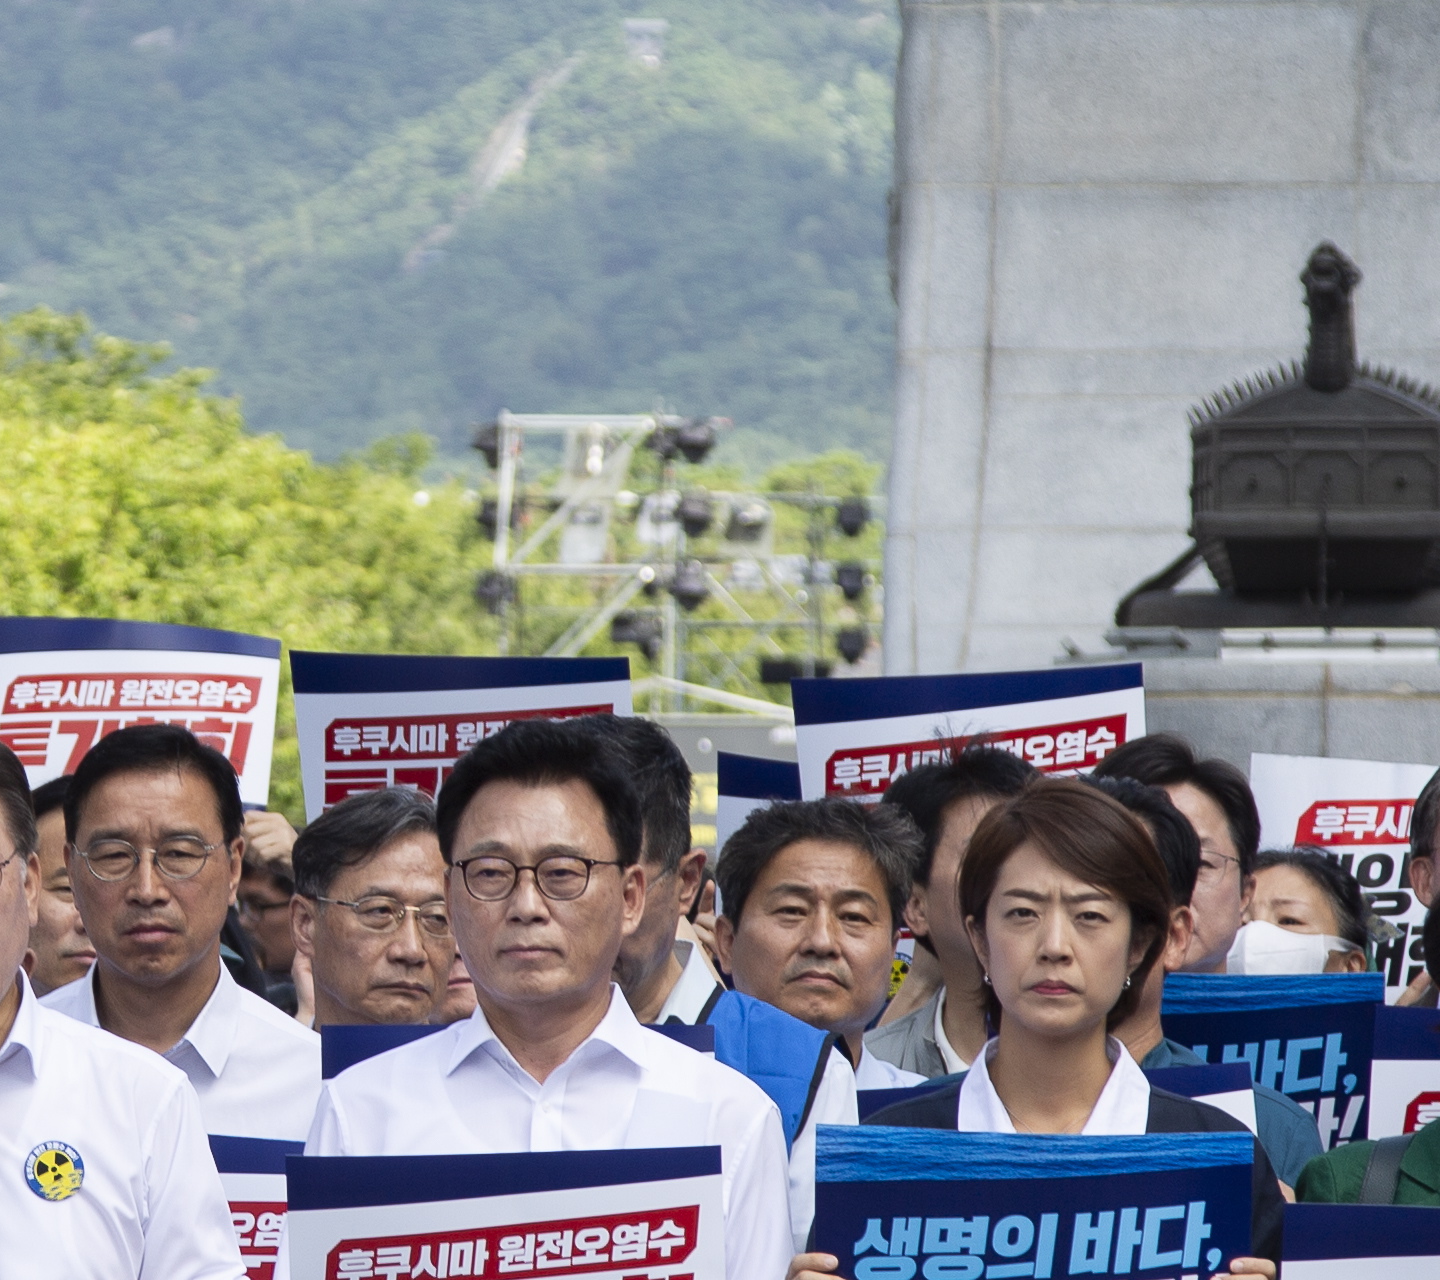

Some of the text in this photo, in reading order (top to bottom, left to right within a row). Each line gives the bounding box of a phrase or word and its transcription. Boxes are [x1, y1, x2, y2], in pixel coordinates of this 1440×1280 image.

[11, 679, 252, 708] 후쿠시마 원전오염수
[333, 724, 449, 756] 후쿠시마
[970, 726, 1116, 767] 오염수
[1312, 803, 1411, 840] 후쿠시
[498, 1220, 686, 1270] 원전오염수
[1069, 1201, 1222, 1270] 바다,
